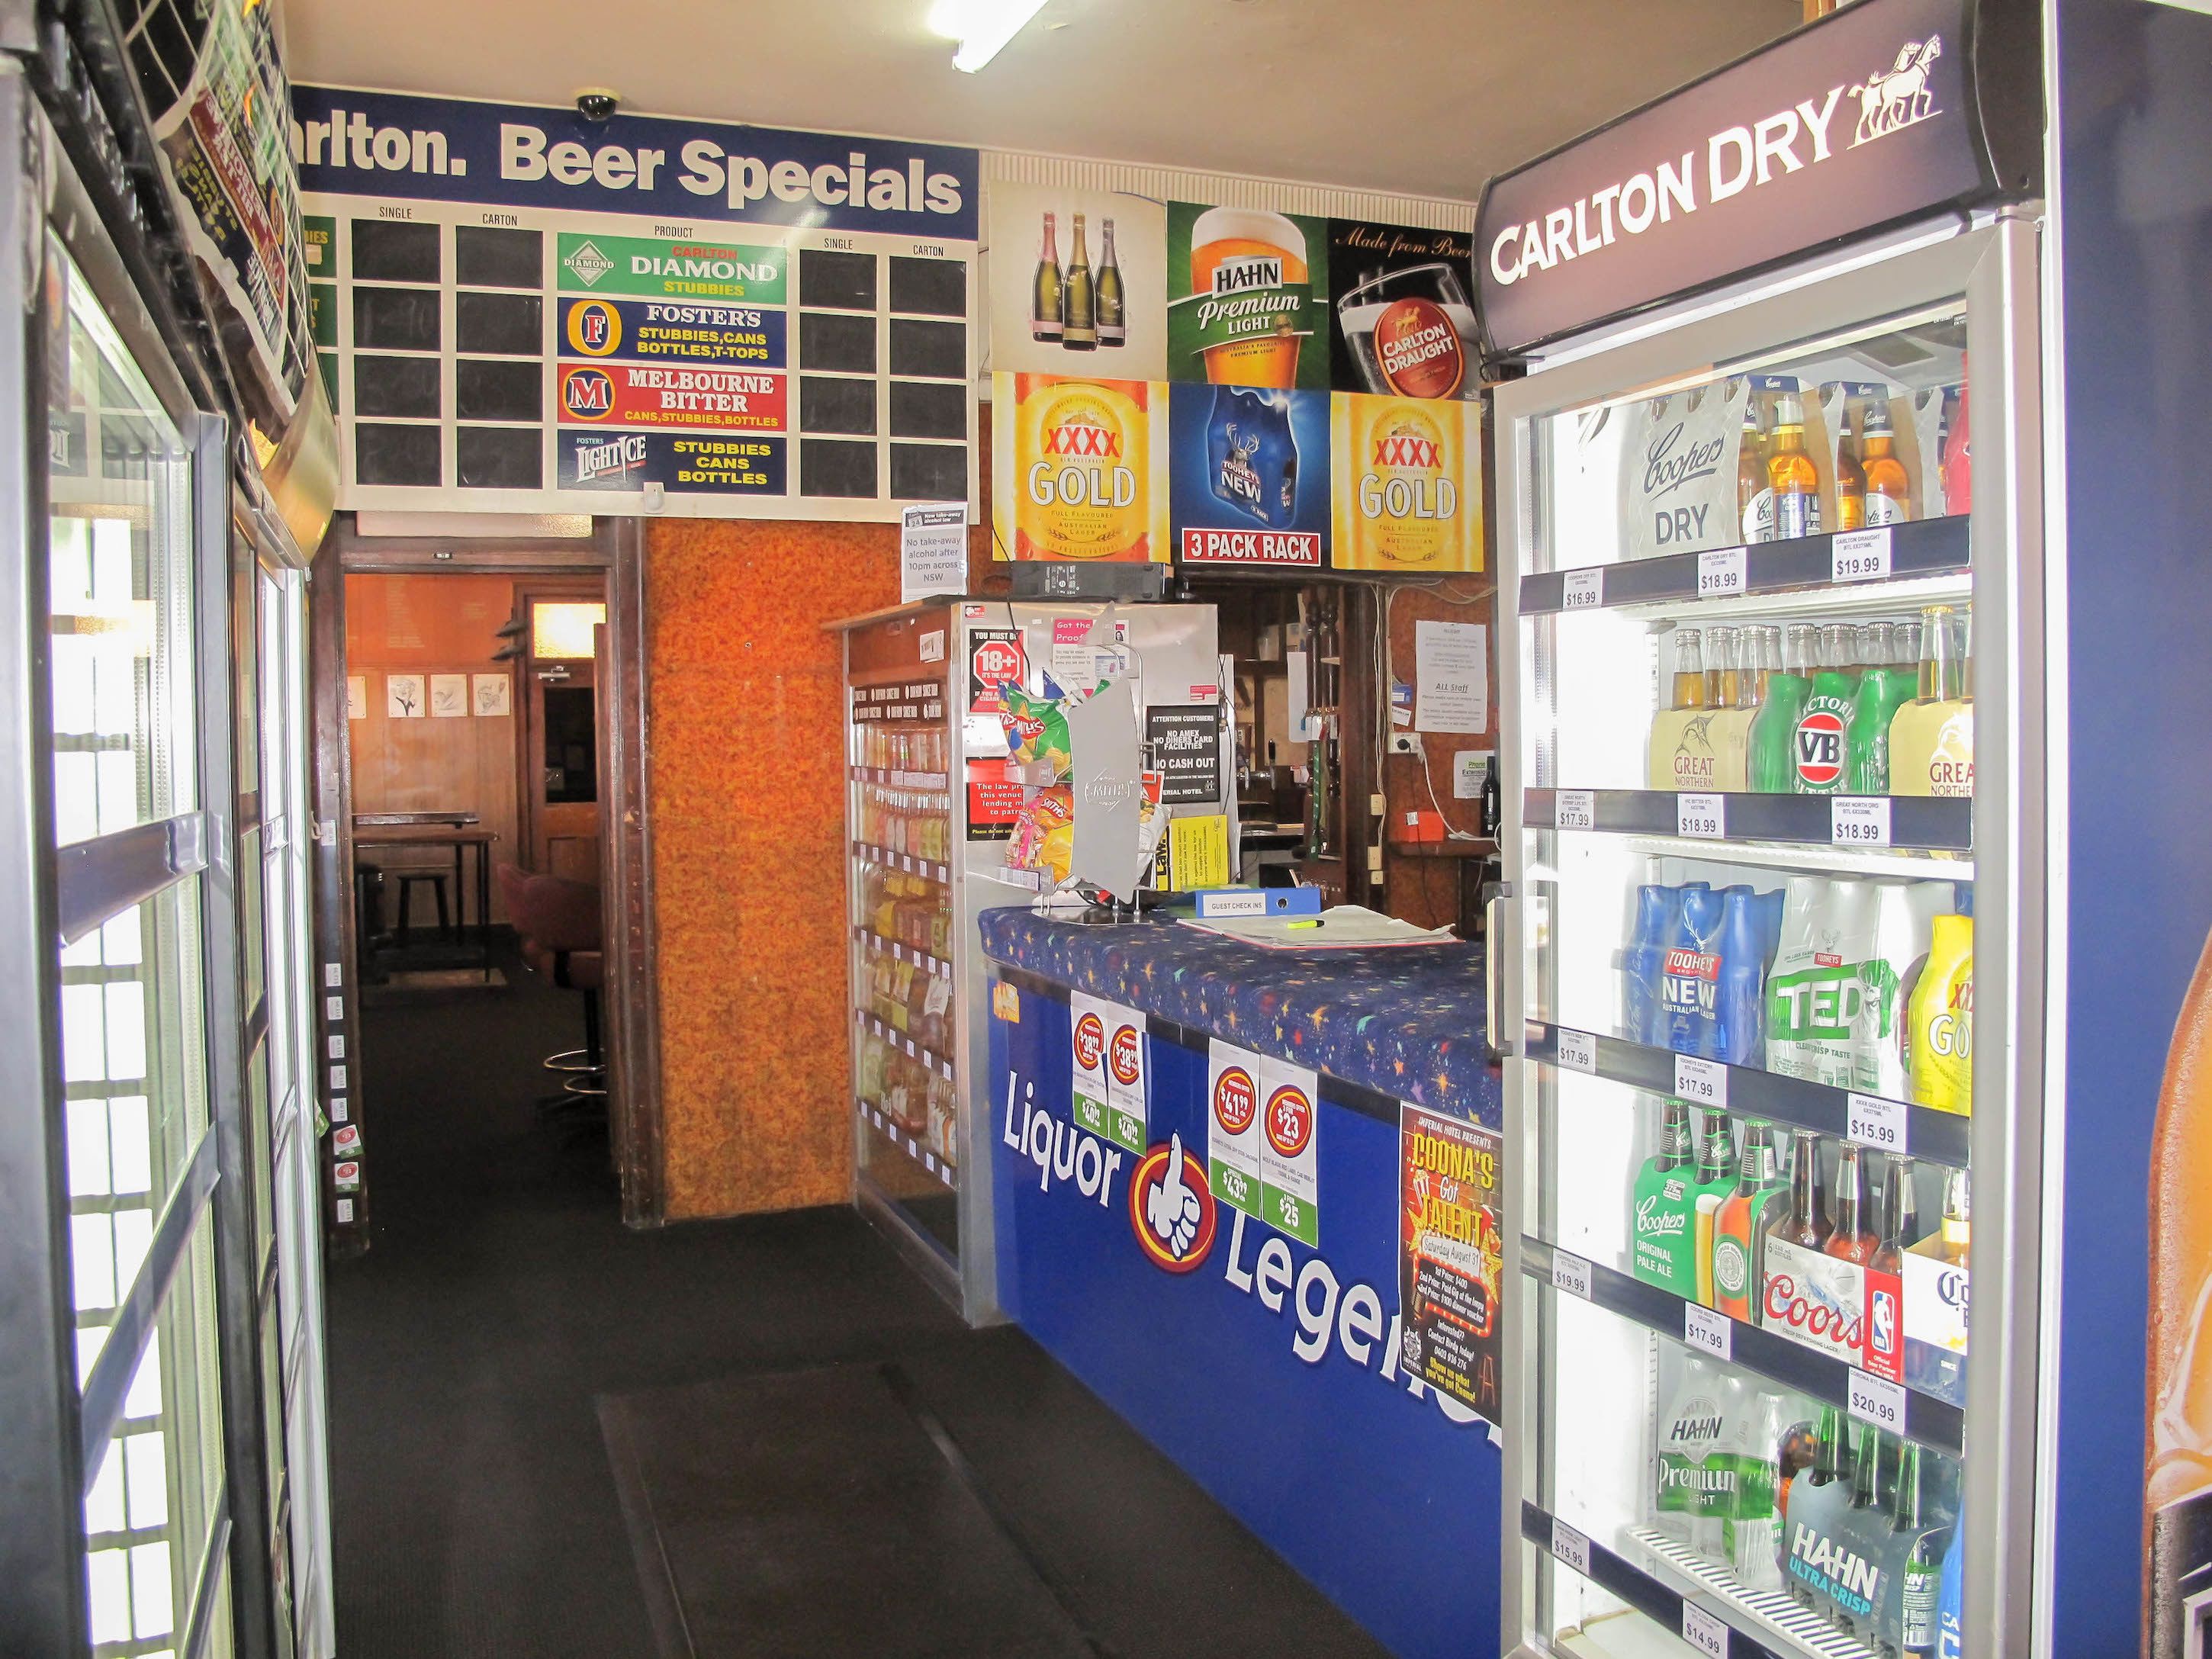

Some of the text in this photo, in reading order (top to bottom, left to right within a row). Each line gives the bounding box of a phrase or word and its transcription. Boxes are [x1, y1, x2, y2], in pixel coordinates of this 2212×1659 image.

[500, 123, 665, 191] Beer
[677, 140, 963, 214] Specials
[1490, 85, 1846, 286] CARLTON DRY
[379, 206, 412, 220] SINGLE
[482, 213, 518, 227] CARTON
[654, 226, 693, 238] PRODUCT
[824, 238, 853, 250] SINGLE
[1336, 227, 1387, 249] Made
[1387, 234, 1426, 258] from
[672, 246, 738, 259] CARLTON
[913, 244, 944, 256] CARTON
[563, 258, 616, 269] DIAMOND
[631, 256, 778, 282] DIAMOND
[664, 281, 744, 296] STUBBIES
[1217, 263, 1278, 293] HAHN
[646, 304, 762, 327] FOSTER'S
[1198, 291, 1301, 330] Premium
[1228, 316, 1270, 335] LIGHT
[1383, 323, 1446, 357] CARLTON
[1384, 336, 1454, 375] DRAUGHT
[569, 377, 609, 409] M
[628, 369, 774, 394] MELBOURNE
[661, 391, 748, 413] BITTER
[576, 437, 604, 445] FOSTERS
[674, 441, 772, 456] STUBBIES
[1043, 427, 1120, 458] XXXX
[1374, 438, 1442, 468] XXXX
[696, 457, 751, 470] CANS
[1644, 422, 1726, 496] Coopers
[678, 471, 767, 485] BOTTLES
[1028, 461, 1136, 508] GOLD
[1221, 471, 1260, 503] NEW
[1359, 473, 1456, 519] GOLD
[1655, 503, 1709, 545] DRY
[908, 549, 937, 558] alcohol
[920, 537, 961, 546] take-away
[1191, 532, 1313, 561] 3 PACK RACK
[909, 562, 931, 571] 10pm
[1837, 557, 1879, 575] $19.99
[1702, 573, 1737, 590] $18.99
[1566, 591, 1596, 606] $16.99
[979, 651, 1016, 672] 18+
[1451, 683, 1469, 693] Staff
[1798, 731, 1840, 763] VB
[1169, 757, 1215, 769] CASH OUT
[1674, 757, 1715, 775] GREAT
[1929, 763, 1974, 783] GREA
[1675, 776, 1714, 787] NORTHERN
[1931, 785, 1971, 797] NORTHE
[1560, 812, 1589, 826] $17.99
[1682, 818, 1716, 832] $18.99
[1836, 823, 1879, 840] $18.99
[1668, 951, 1714, 972] TOOHEYS
[1817, 953, 1839, 964] TOOHEYS
[1663, 976, 1715, 1009] NEW
[1776, 977, 1860, 1030] TED
[1663, 1003, 1699, 1014] AUSTRALIAN
[1928, 1014, 1970, 1059] GO
[1560, 1047, 1589, 1065] $17.99
[1831, 1049, 1850, 1059] TASTE
[1679, 1076, 1713, 1096] $17.99
[1277, 1108, 1299, 1140] $23
[1418, 1117, 1492, 1149] IMPERIAL HOTEL PRESENTS
[1851, 1119, 1895, 1143] $15.99
[1003, 1070, 1121, 1208] Liquor
[1413, 1133, 1494, 1189] COONA'S
[1440, 1175, 1458, 1203] Got
[1279, 1197, 1299, 1227] $25
[1421, 1193, 1483, 1247] TALENT
[1635, 1194, 1686, 1235] Coopers
[1424, 1237, 1479, 1265] Saturday August 31
[1637, 1239, 1673, 1263] ORIGINAL
[1767, 1243, 1773, 1252] 6
[1637, 1254, 1673, 1278] PALE ALE
[1419, 1271, 1451, 1294] 2nd Paid
[1455, 1275, 1468, 1289] $400
[1556, 1271, 1585, 1292] $19.99
[1441, 1291, 1484, 1323] $100 dinner voucher
[1763, 1271, 1864, 1349] Coors
[1427, 1328, 1443, 1345] Contact
[1459, 1345, 1474, 1362] today!
[1688, 1323, 1722, 1349] $17.99
[1434, 1346, 1467, 1371] 0403 276
[1824, 1344, 1839, 1353] LAGER
[1873, 1355, 1890, 1365] Official
[1429, 1356, 1470, 1388] Show what
[1850, 1369, 1870, 1384] CORONA
[1868, 1359, 1896, 1374] Beer Partner
[1853, 1392, 1895, 1422] $20.99
[1670, 1416, 1722, 1440] HAHN
[1555, 1540, 1583, 1566] $15.99
[1792, 1522, 1879, 1600] HAHN
[1789, 1556, 1829, 1593] ULTRA
[1831, 1582, 1872, 1616] CRISP
[1686, 1622, 1719, 1654] $14.99
